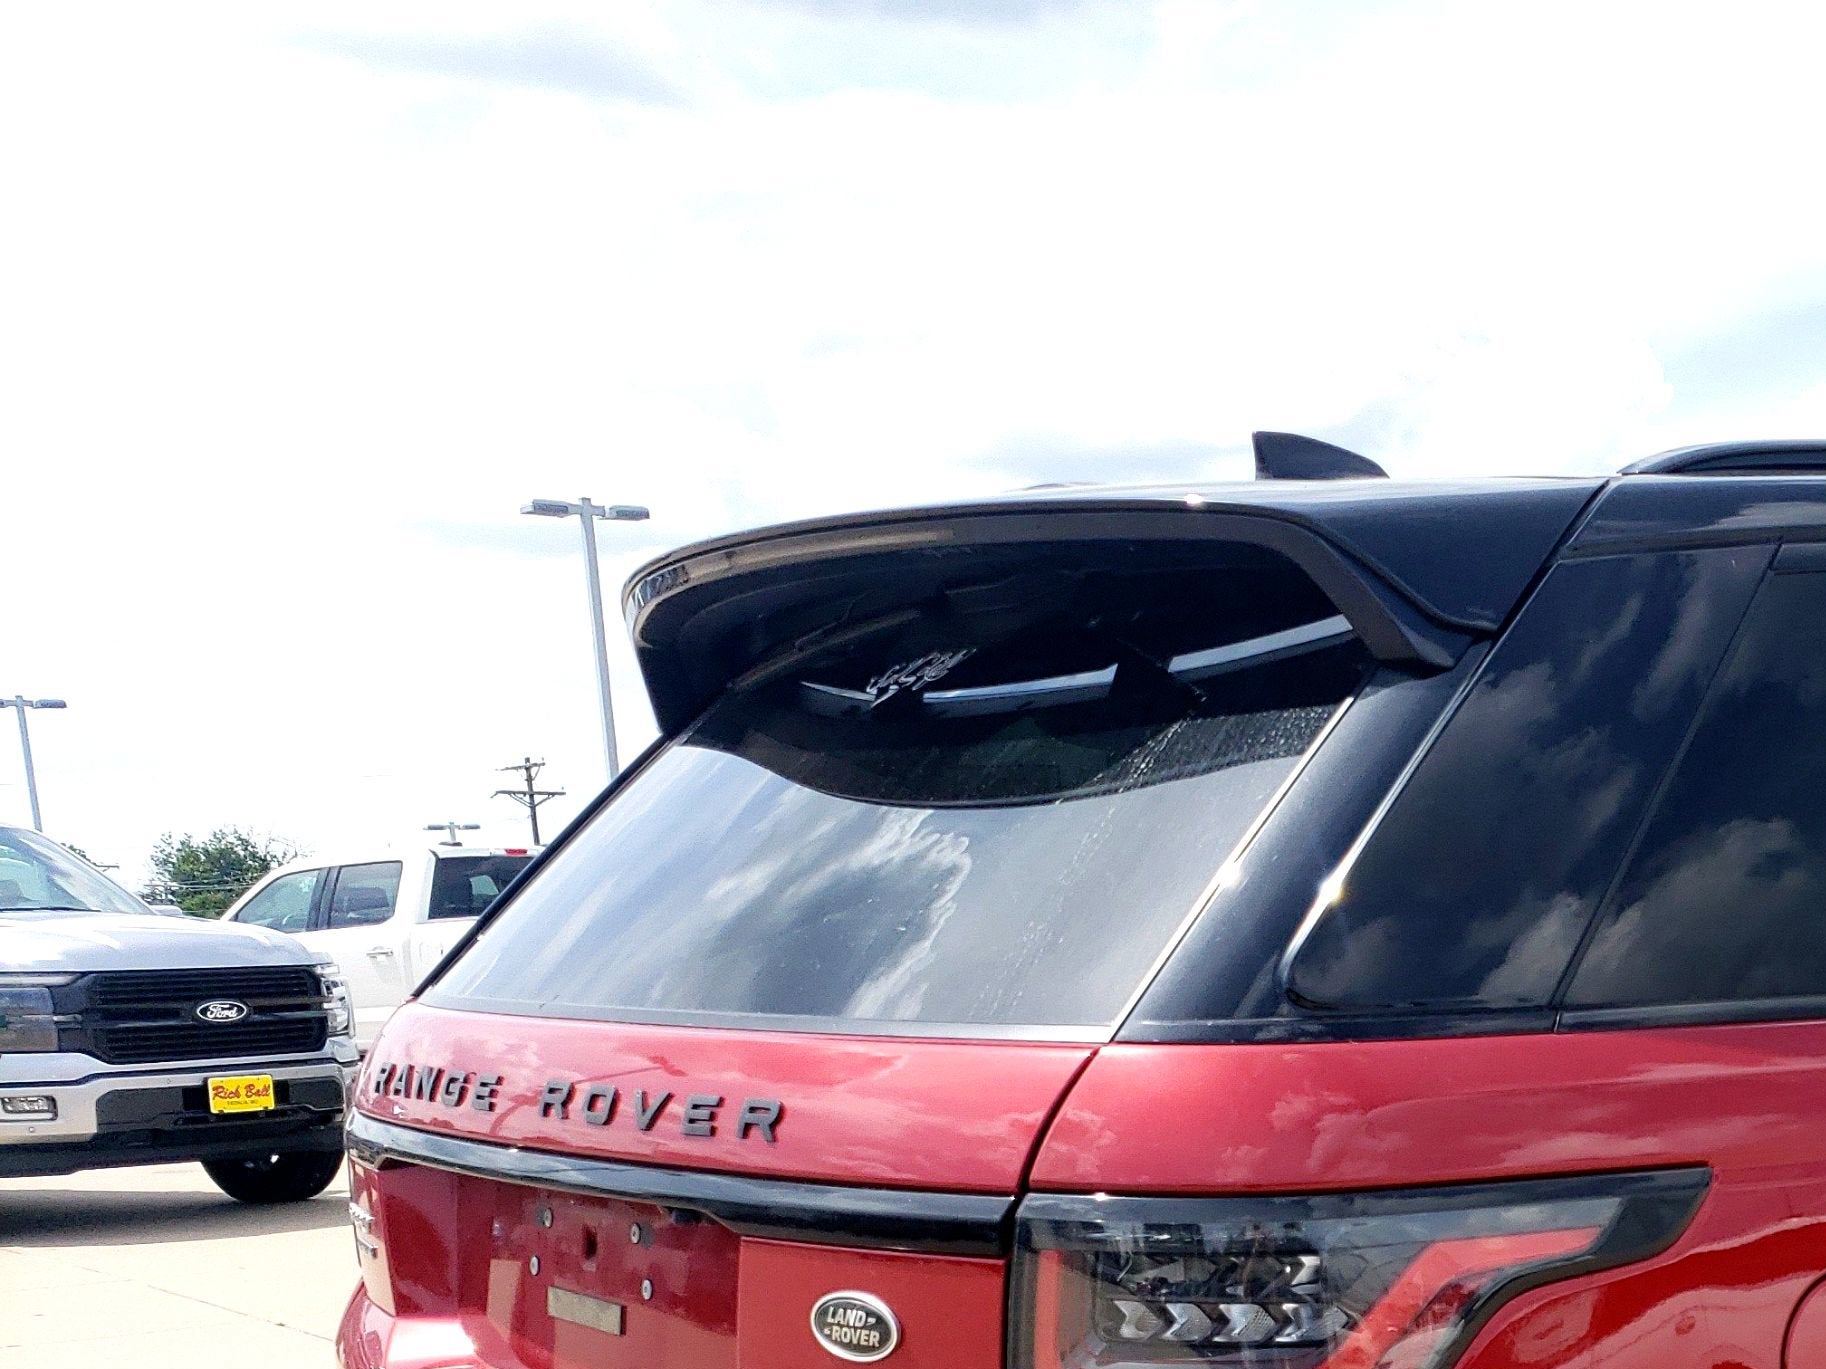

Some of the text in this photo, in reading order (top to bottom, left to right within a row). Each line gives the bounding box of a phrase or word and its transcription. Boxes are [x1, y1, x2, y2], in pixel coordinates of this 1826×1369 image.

[206, 1003, 238, 1019] Ford
[212, 1083, 271, 1100] Rick Ball
[372, 1061, 784, 1144] RANGE ROVER
